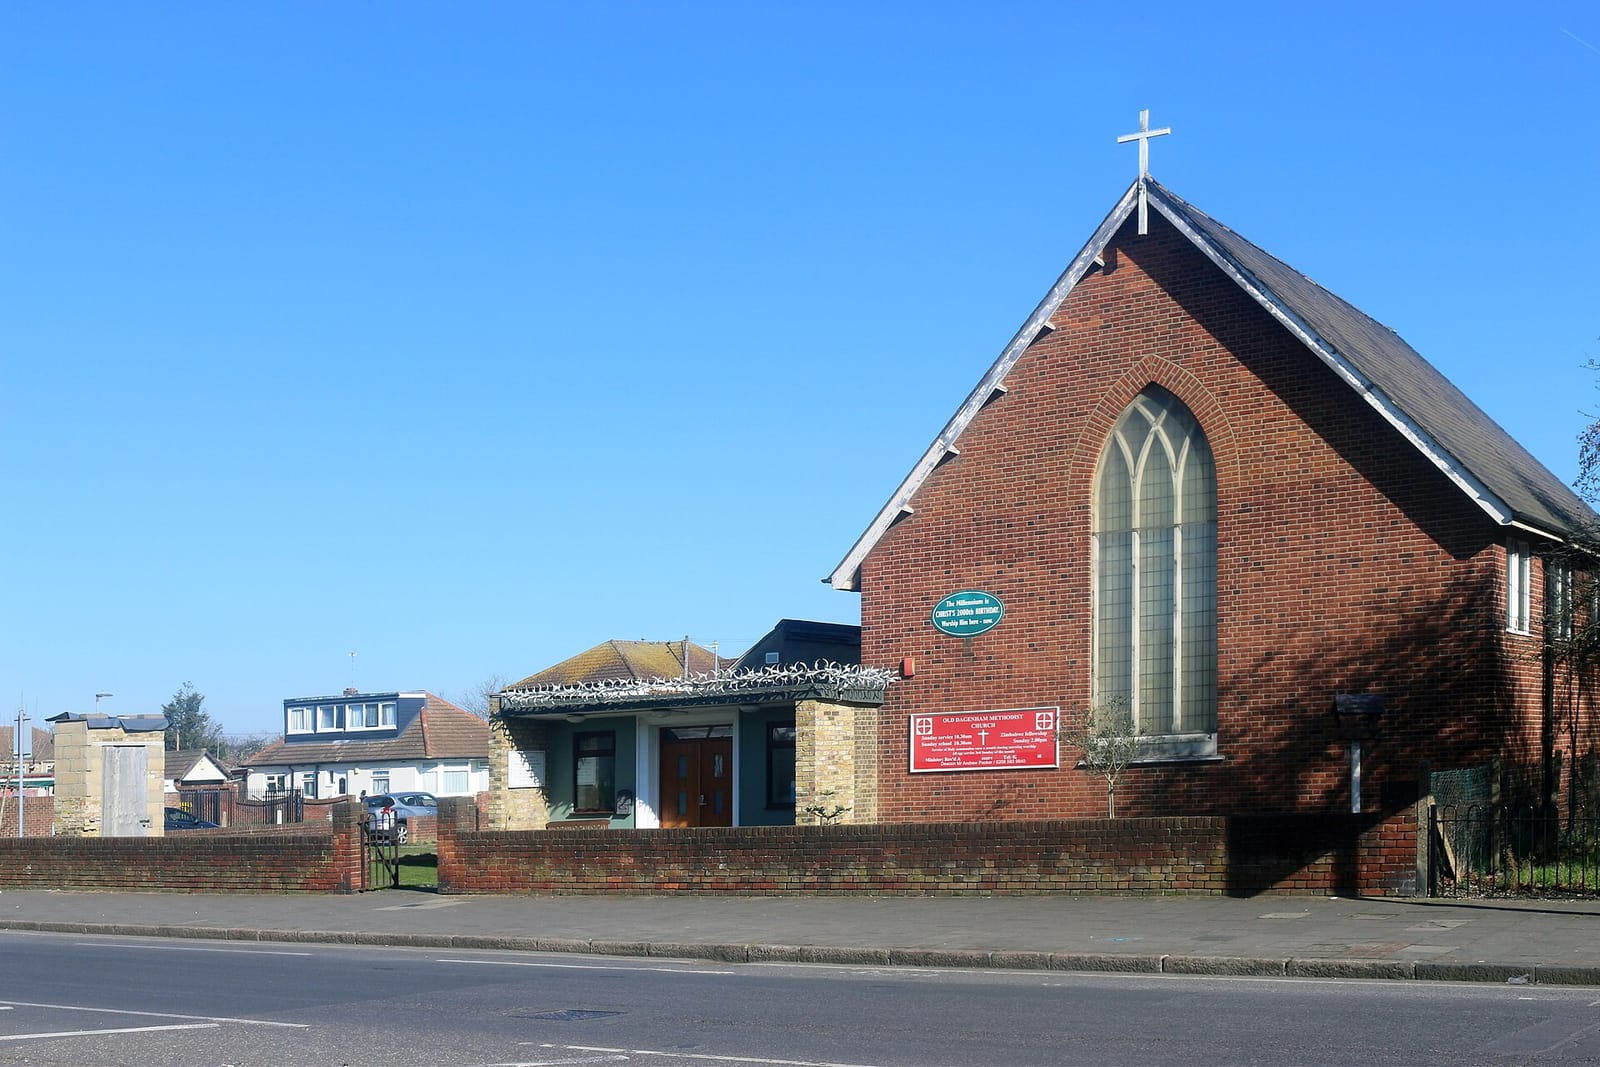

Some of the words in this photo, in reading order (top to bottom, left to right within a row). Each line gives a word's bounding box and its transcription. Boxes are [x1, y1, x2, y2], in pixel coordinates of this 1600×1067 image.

[956, 598, 983, 606] Millennium
[936, 610, 956, 618] CHRIST'S
[956, 608, 974, 616] 2000th
[942, 620, 958, 628] Worship
